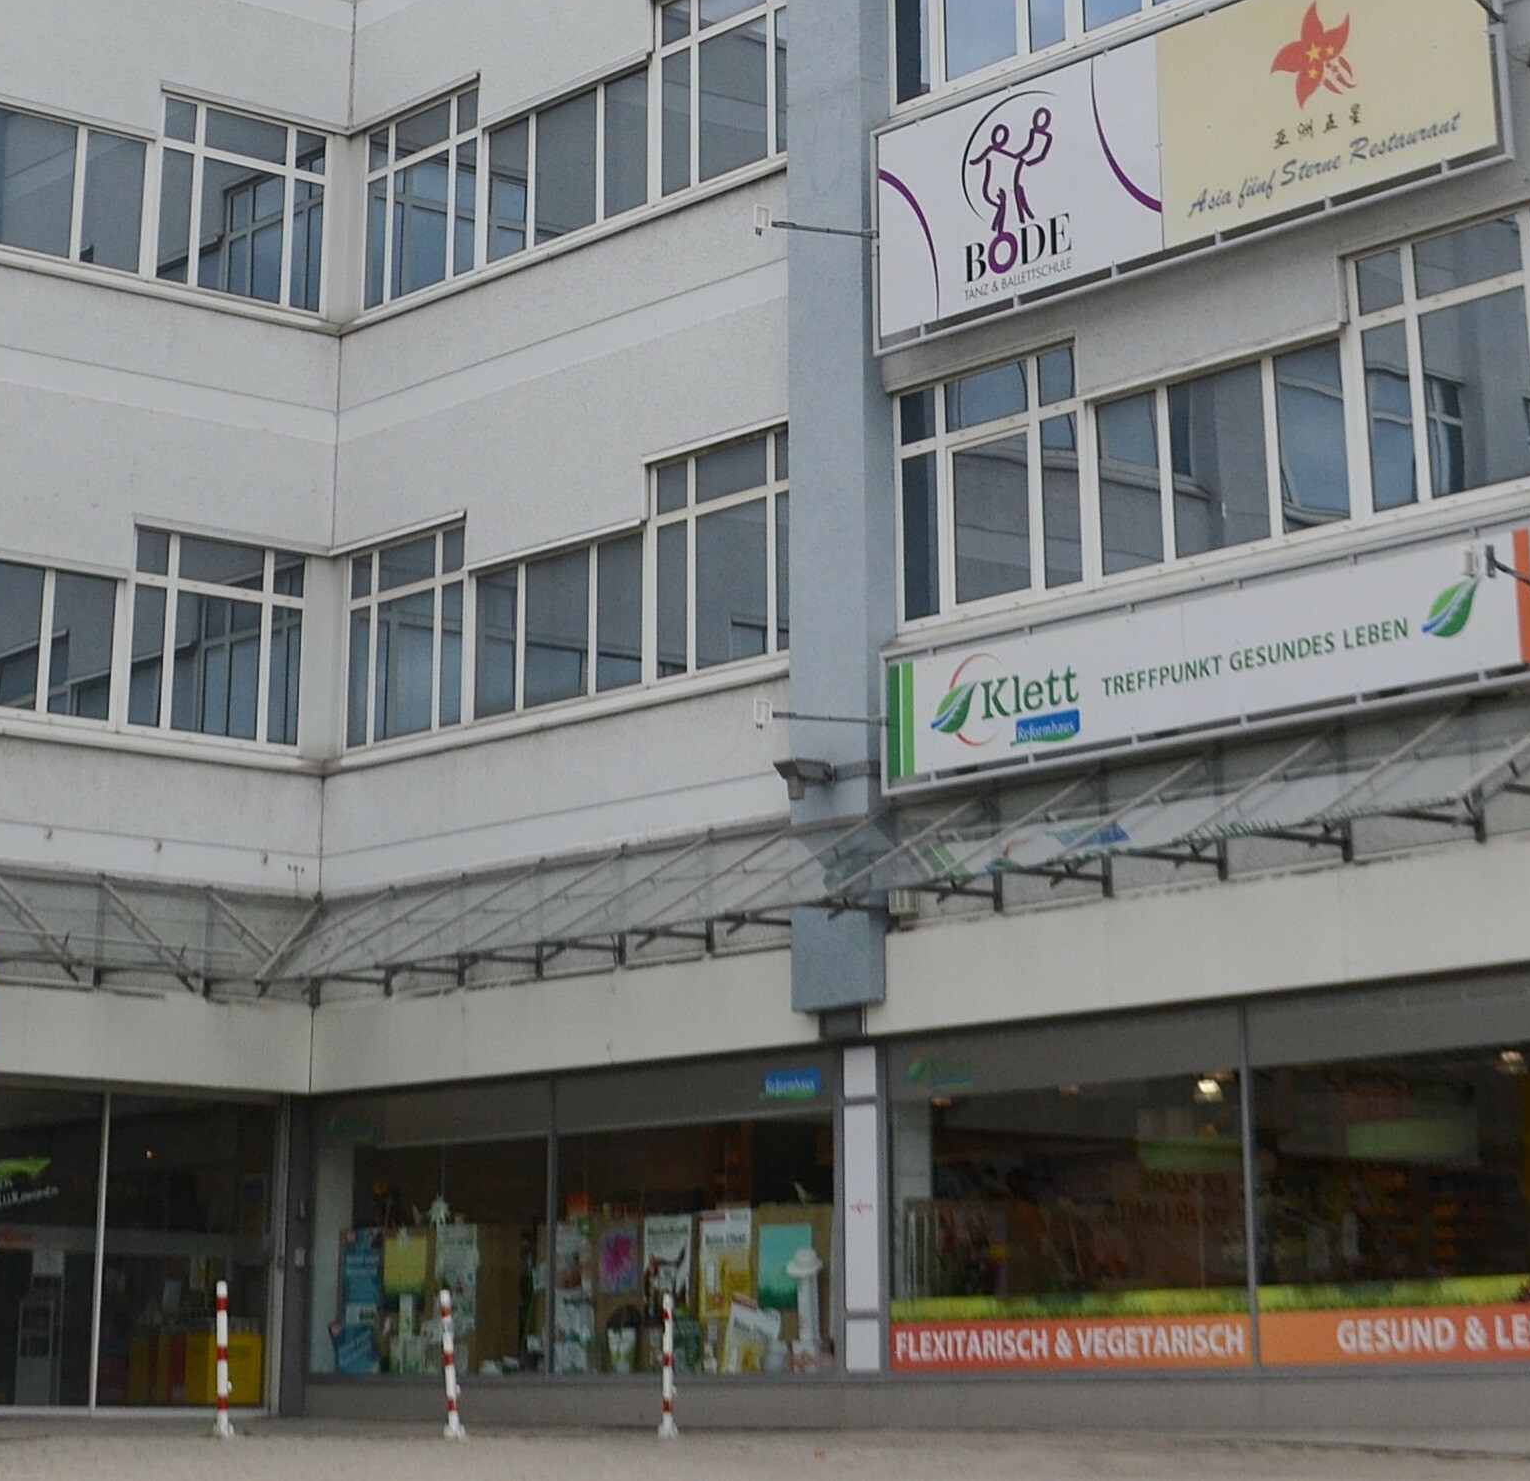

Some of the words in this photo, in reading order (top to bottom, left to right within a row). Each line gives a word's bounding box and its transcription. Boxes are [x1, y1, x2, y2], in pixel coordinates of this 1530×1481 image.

[1188, 188, 1232, 219] Asia
[1238, 169, 1275, 209] fünf
[1280, 155, 1342, 188] Sterne
[1349, 111, 1462, 165] Restaurant
[965, 213, 1072, 284] BODE
[965, 284, 989, 299] TANZ
[991, 281, 999, 293] &
[1001, 258, 1072, 290] BALLETTSCHULE
[981, 665, 1079, 721] Klett
[1101, 655, 1223, 698] TREFFPUNKT
[1229, 634, 1336, 672] GESUNDES
[1343, 618, 1410, 652] LEBEN
[895, 1327, 1049, 1363] FLEXITARISCH
[1054, 1327, 1073, 1358] &
[1076, 1323, 1245, 1359] VEGETARISCH
[1336, 1317, 1454, 1356] GESUND
[1464, 1315, 1488, 1350] &
